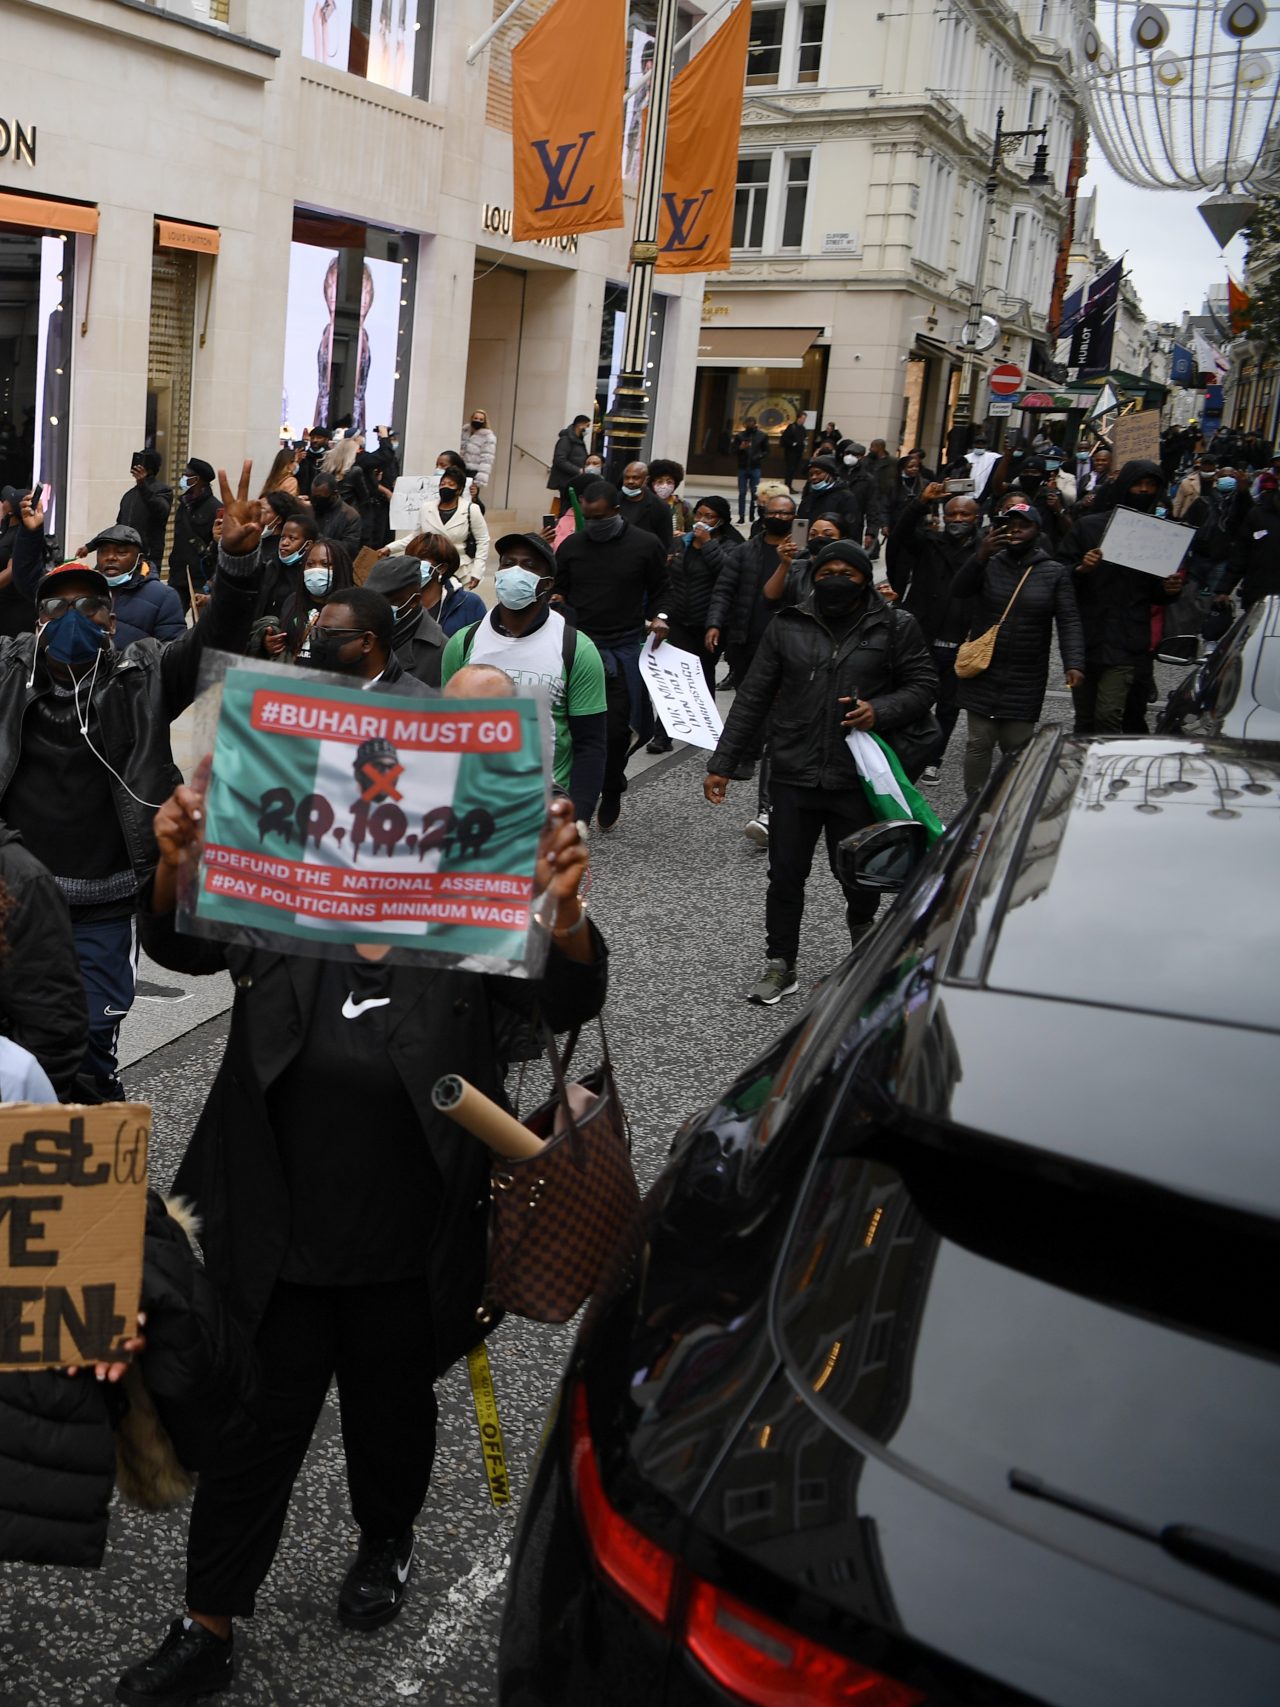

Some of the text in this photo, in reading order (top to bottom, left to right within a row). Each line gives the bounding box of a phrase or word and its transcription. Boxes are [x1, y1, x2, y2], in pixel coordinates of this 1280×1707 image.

[482, 203, 513, 237] LOU
[1077, 327, 1093, 365] HUBLOT
[261, 701, 513, 744] #BUHARI MUST GO
[257, 787, 495, 863] 20.10.20
[205, 848, 533, 896] #DEFUND THE NATIONAL ASSEMBLY
[211, 874, 526, 925] #PAY POLITICIANS MINIMUM WAGE
